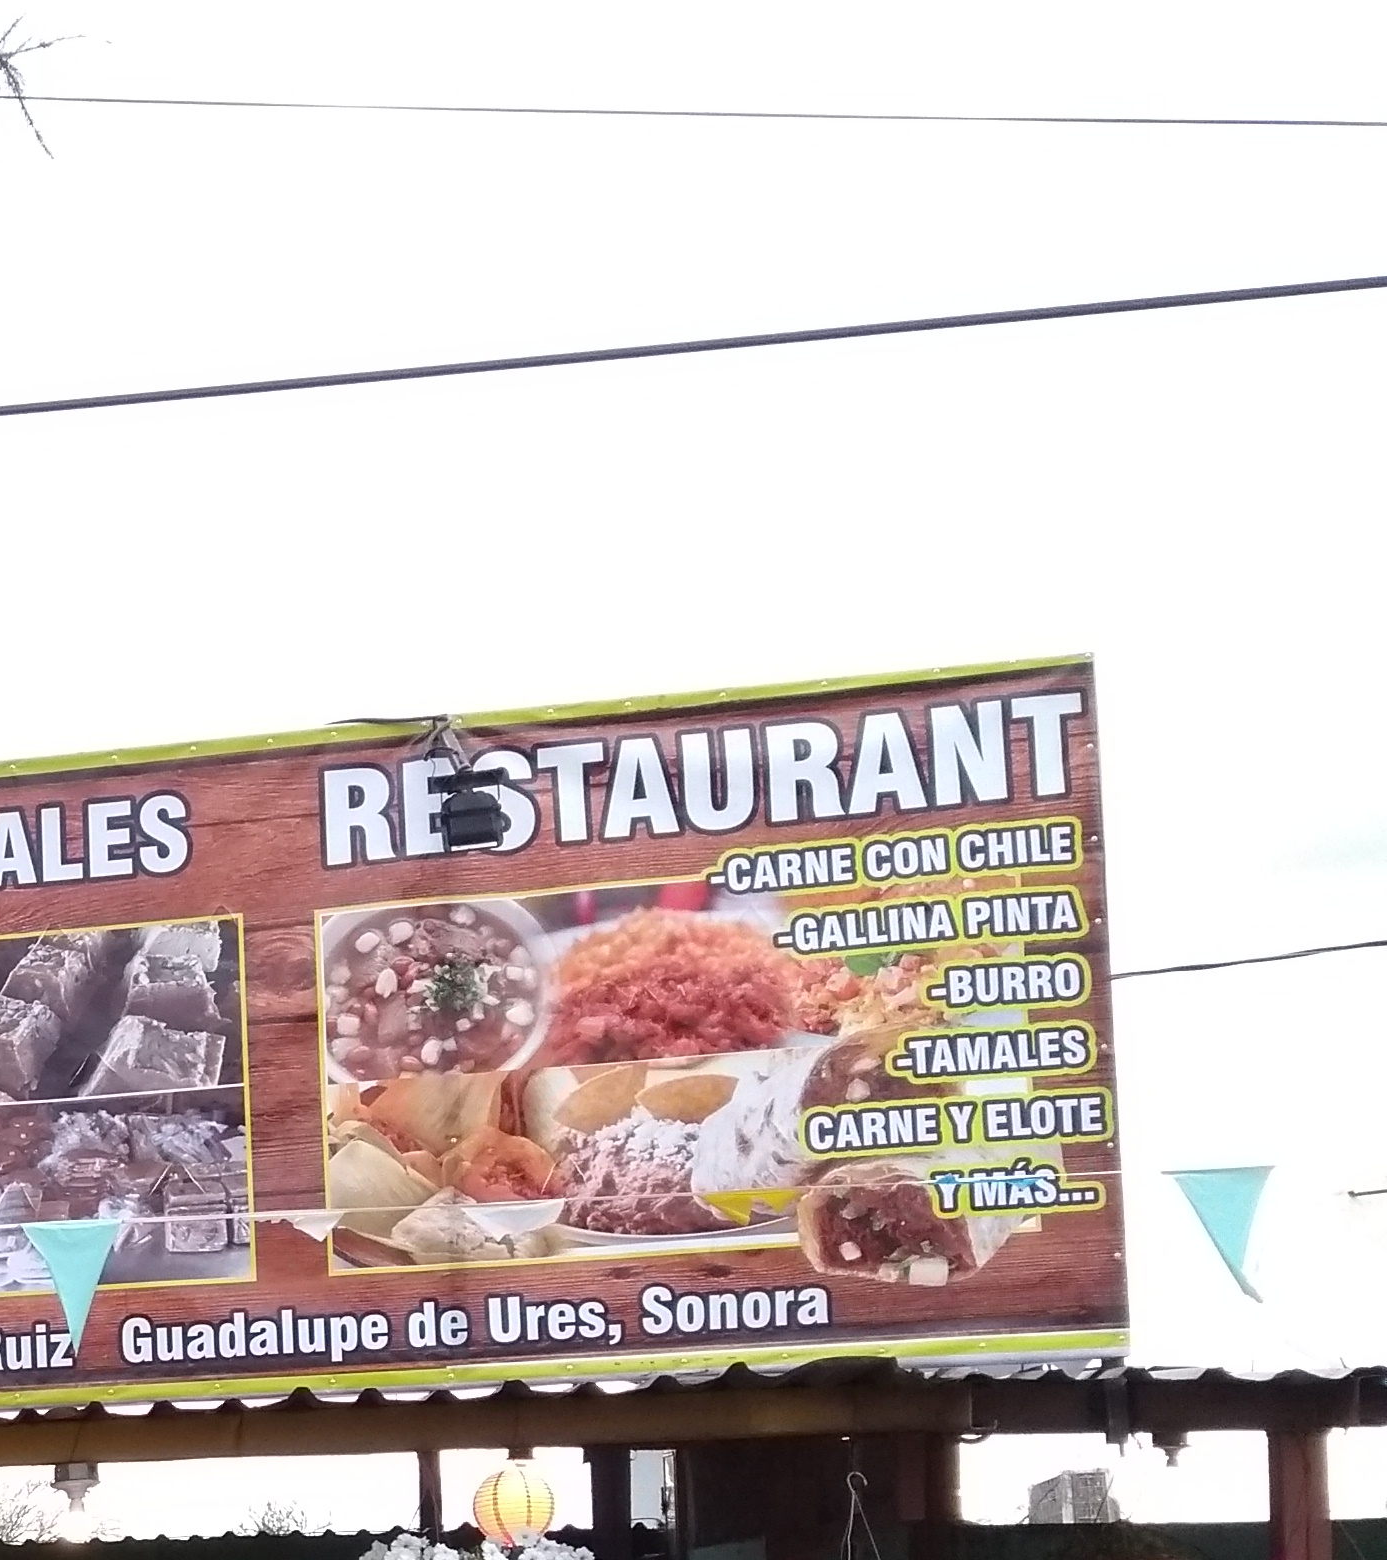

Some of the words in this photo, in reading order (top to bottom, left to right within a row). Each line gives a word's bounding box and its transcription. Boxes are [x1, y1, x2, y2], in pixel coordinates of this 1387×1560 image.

[320, 692, 1083, 866] RESTAURANT
[710, 846, 854, 893] -CARNE
[866, 836, 947, 881] CON
[960, 826, 1073, 870] CHILE
[777, 903, 955, 951] -GALLINA
[967, 894, 1079, 936] PINTA
[930, 964, 1082, 1006] -BURRO
[896, 1029, 1086, 1075] -TAMALES
[809, 1106, 939, 1151] CARNE
[947, 1105, 975, 1140] Y
[986, 1096, 1104, 1139] ELOTE
[935, 1174, 961, 1210] Y
[122, 1309, 389, 1363] Guadalupe
[408, 1301, 468, 1348] de
[487, 1295, 622, 1345] Ures,
[641, 1286, 829, 1335] Sonora
